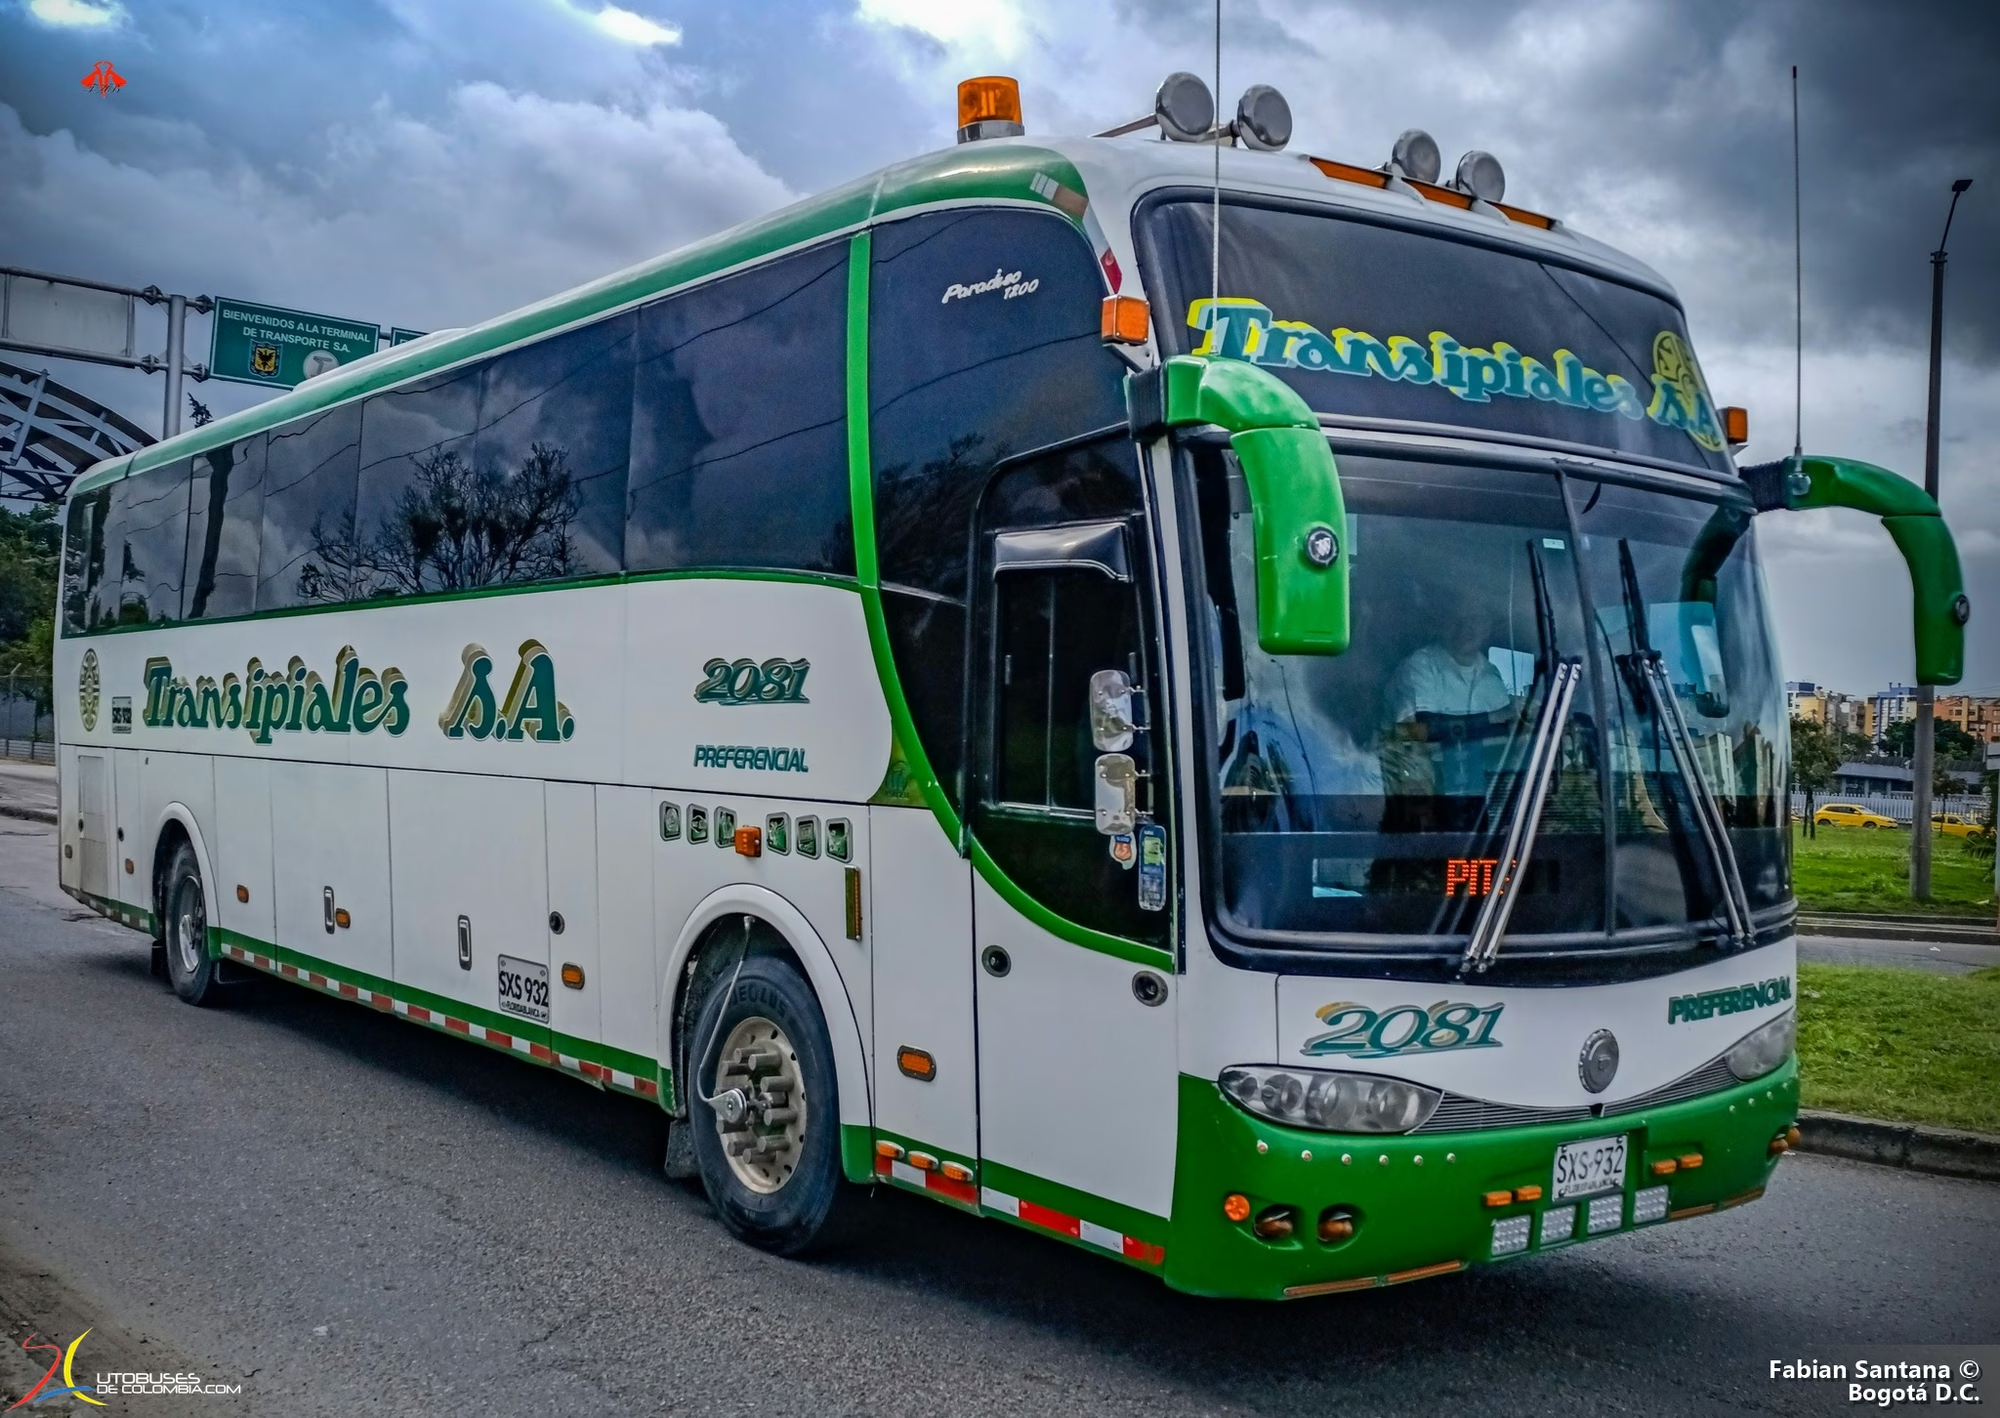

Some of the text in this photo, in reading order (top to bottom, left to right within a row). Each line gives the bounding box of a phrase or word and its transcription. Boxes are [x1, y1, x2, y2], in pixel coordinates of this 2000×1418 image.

[941, 268, 1022, 304] Paradiso
[1004, 279, 1040, 300] 1200
[222, 309, 370, 343] BIENVENIDOS A LA TERMINAL
[243, 327, 257, 338] DE
[259, 329, 330, 350] TRANSPORTE
[1186, 297, 1645, 421] Transipiales
[143, 638, 576, 745] Transipiales S.A.
[694, 657, 811, 706] 2081
[693, 744, 809, 773] PREFERENCIAL
[499, 970, 549, 1008] SXS 932
[1668, 976, 1791, 1025] PREFERENCIAL
[1300, 1000, 1505, 1060] 2081
